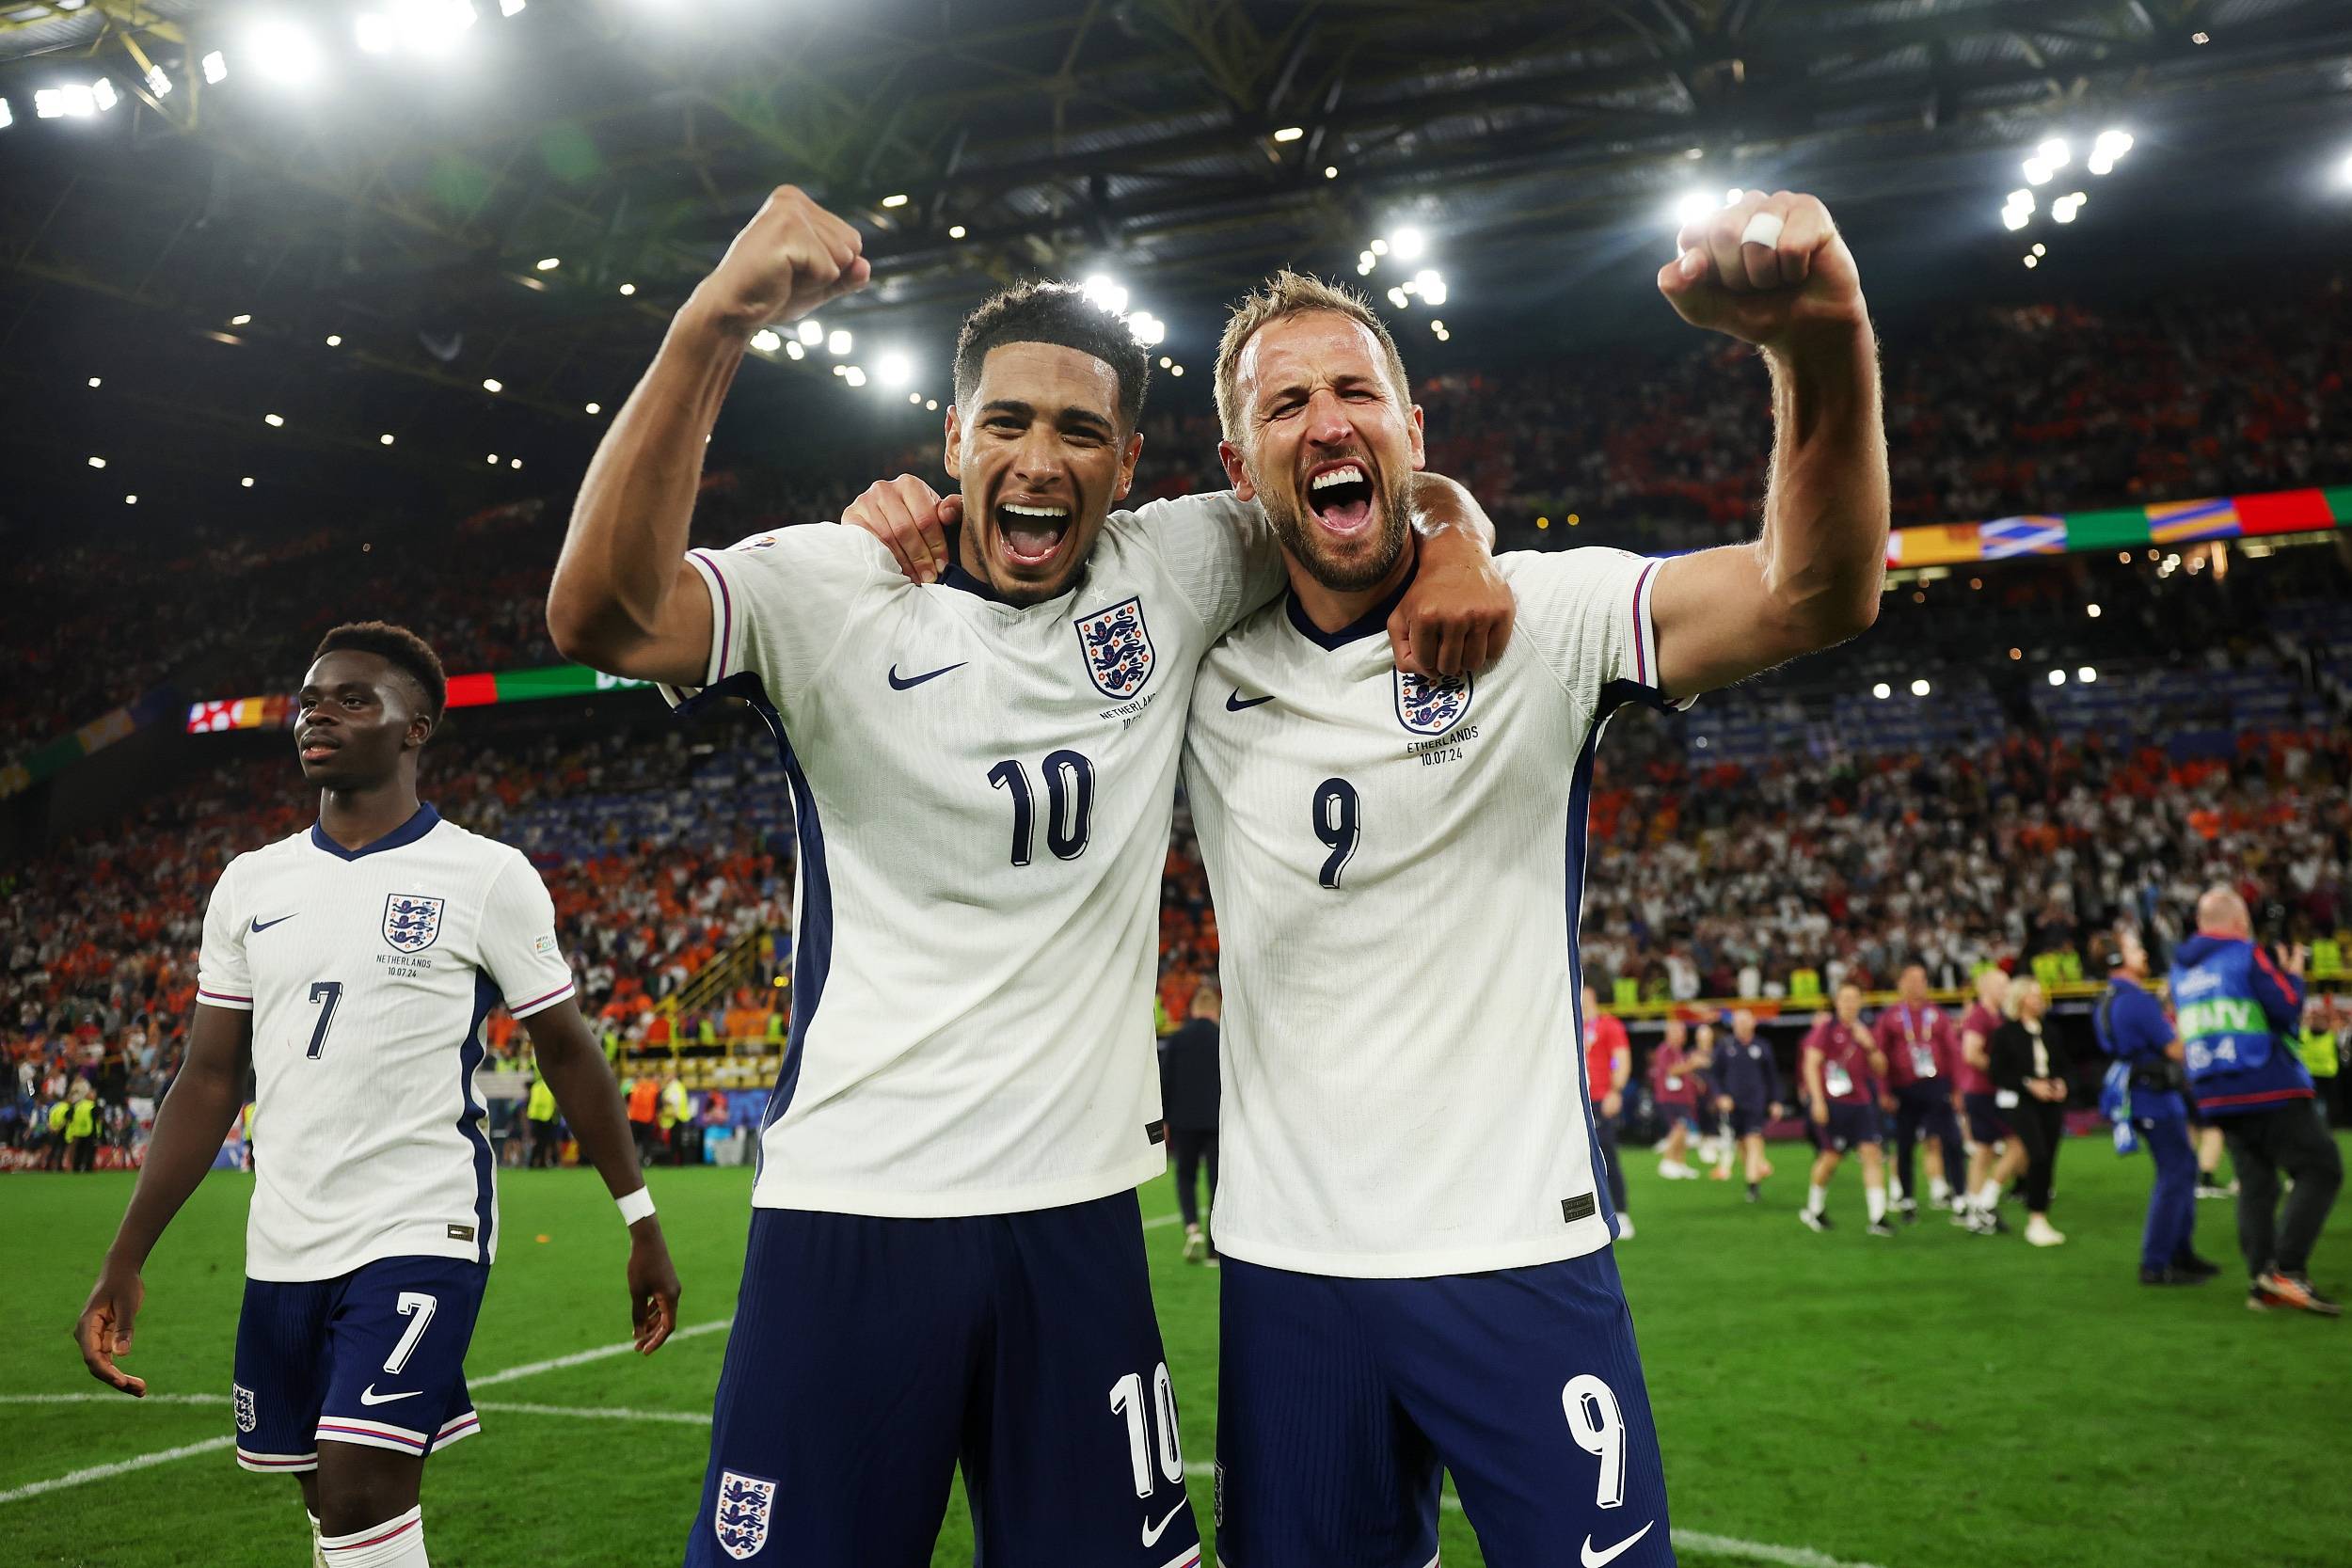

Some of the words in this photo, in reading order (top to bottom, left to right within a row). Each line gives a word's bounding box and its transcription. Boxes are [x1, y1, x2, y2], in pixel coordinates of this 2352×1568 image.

[1421, 748, 1463, 766] 10.07.24
[987, 749, 1095, 867] 10
[1312, 777, 1360, 889] 9
[375, 954, 432, 969] NETHERLANDS
[388, 966, 417, 978] 10.07.24
[307, 981, 343, 1059] 7
[383, 1291, 437, 1375] 7
[1109, 1361, 1184, 1499] 10
[1562, 1374, 1627, 1510] 9
